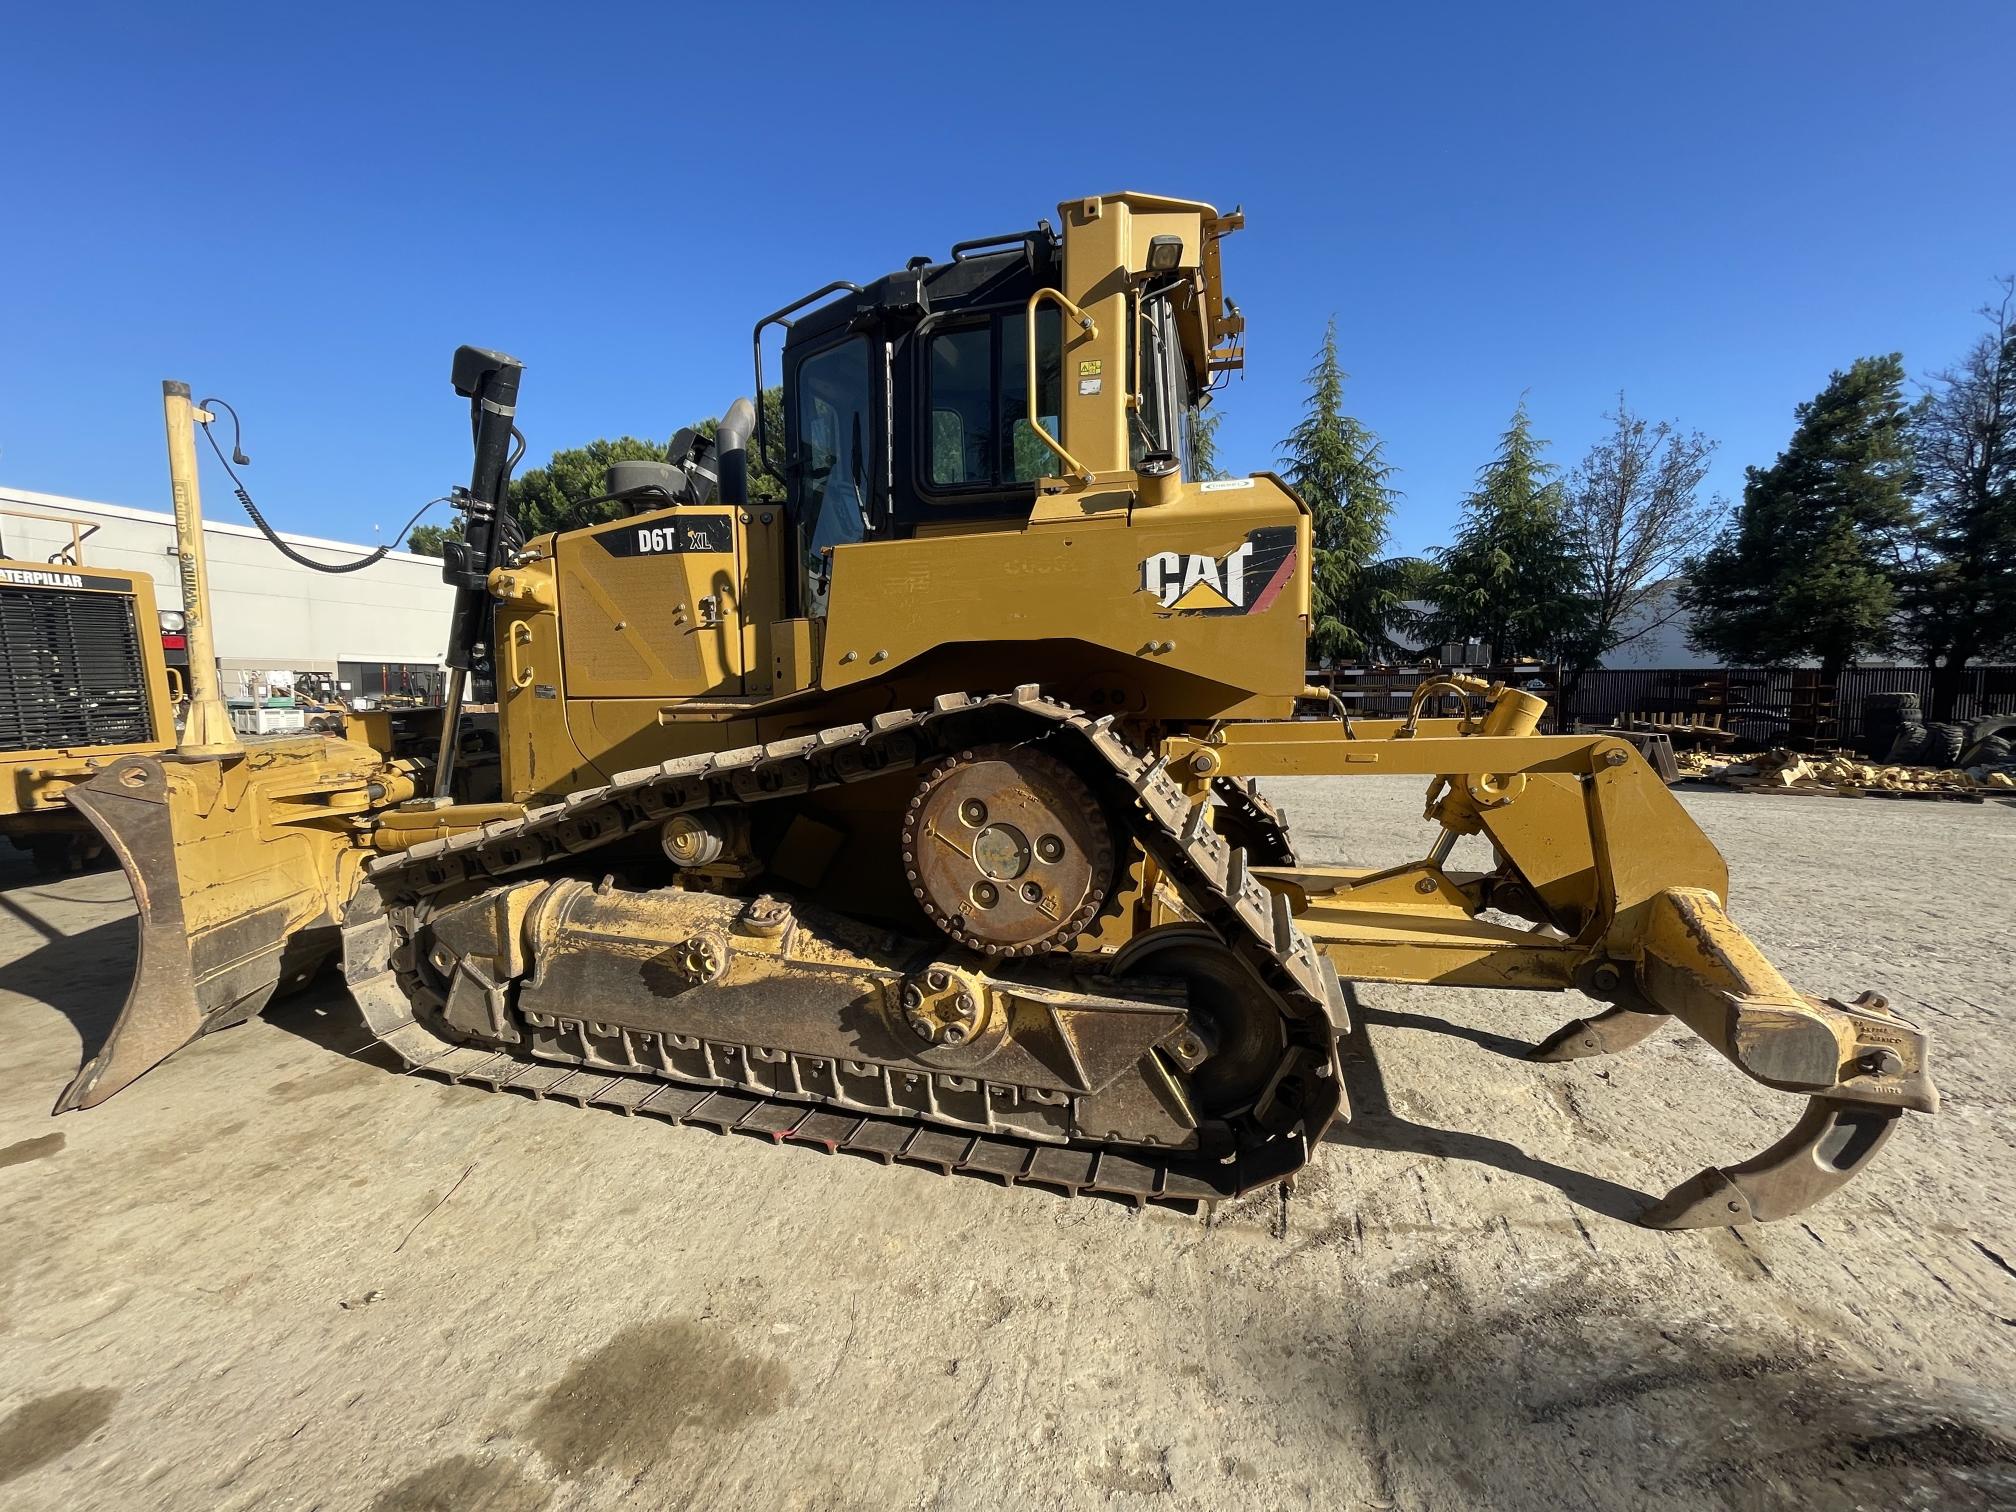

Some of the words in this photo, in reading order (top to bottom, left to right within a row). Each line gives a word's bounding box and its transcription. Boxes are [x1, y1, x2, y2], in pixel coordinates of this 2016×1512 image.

[174, 486, 187, 533] GUIDED
[638, 528, 675, 552] D6T
[689, 532, 712, 549] XL
[0, 569, 83, 587] ATERPILLAR
[1146, 542, 1253, 608] CAT
